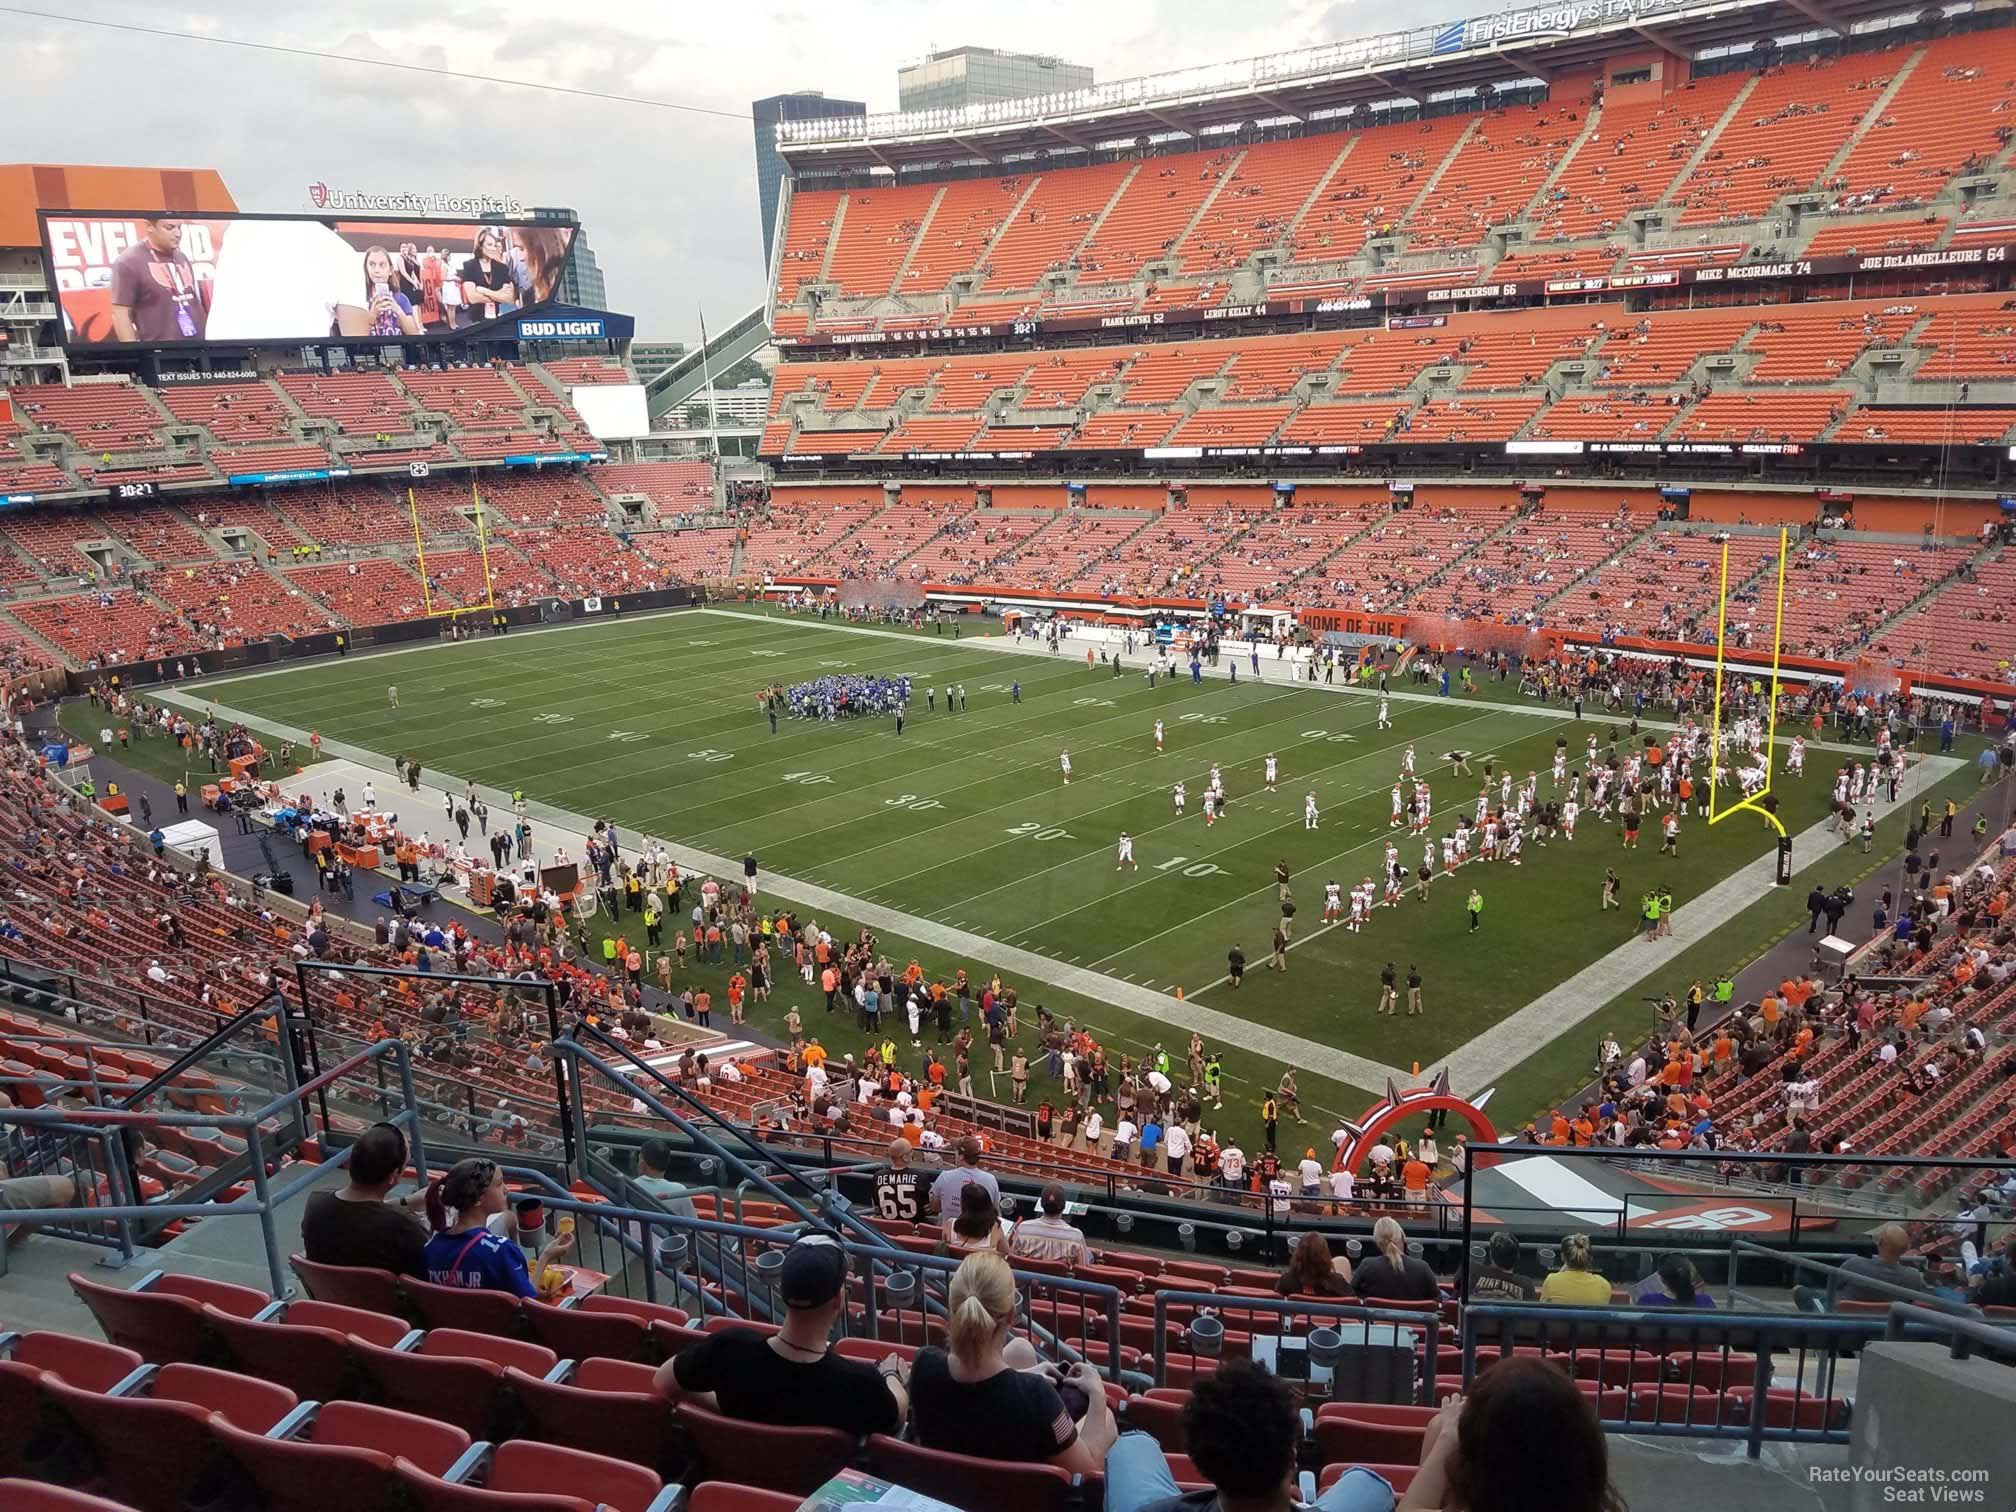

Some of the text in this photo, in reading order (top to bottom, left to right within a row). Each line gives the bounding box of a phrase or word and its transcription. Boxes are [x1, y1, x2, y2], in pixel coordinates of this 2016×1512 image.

[1472, 7, 1583, 42] FirstEnergy
[329, 190, 430, 217] University
[433, 193, 522, 217] Hospitals
[1860, 257, 1882, 270] JOE
[1987, 247, 2006, 261] 64
[1696, 267, 1722, 281] MIKE
[1796, 262, 1811, 275] 74
[1427, 283, 1517, 301] GENE HICKERSON 66
[1101, 316, 1124, 327] FRANK
[1153, 313, 1164, 324] 52
[1204, 304, 1267, 319] LEROY KELLY 44
[522, 322, 600, 335] BUD LIGHT
[832, 333, 886, 344] CHAMPIONSHIPS
[177, 372, 201, 381] ISSUES
[202, 372, 212, 380] TO
[412, 464, 426, 476] 25
[120, 484, 153, 498] 30:27
[1303, 614, 1394, 636] HOME OF THE
[688, 749, 735, 762] 50
[885, 794, 938, 811] 30
[1005, 822, 1065, 841] 20
[1154, 856, 1219, 877] 10
[1227, 1158, 1240, 1169] 73
[877, 1174, 918, 1186] DEMARIE
[878, 1184, 918, 1220] 65
[466, 1270, 482, 1288] JR
